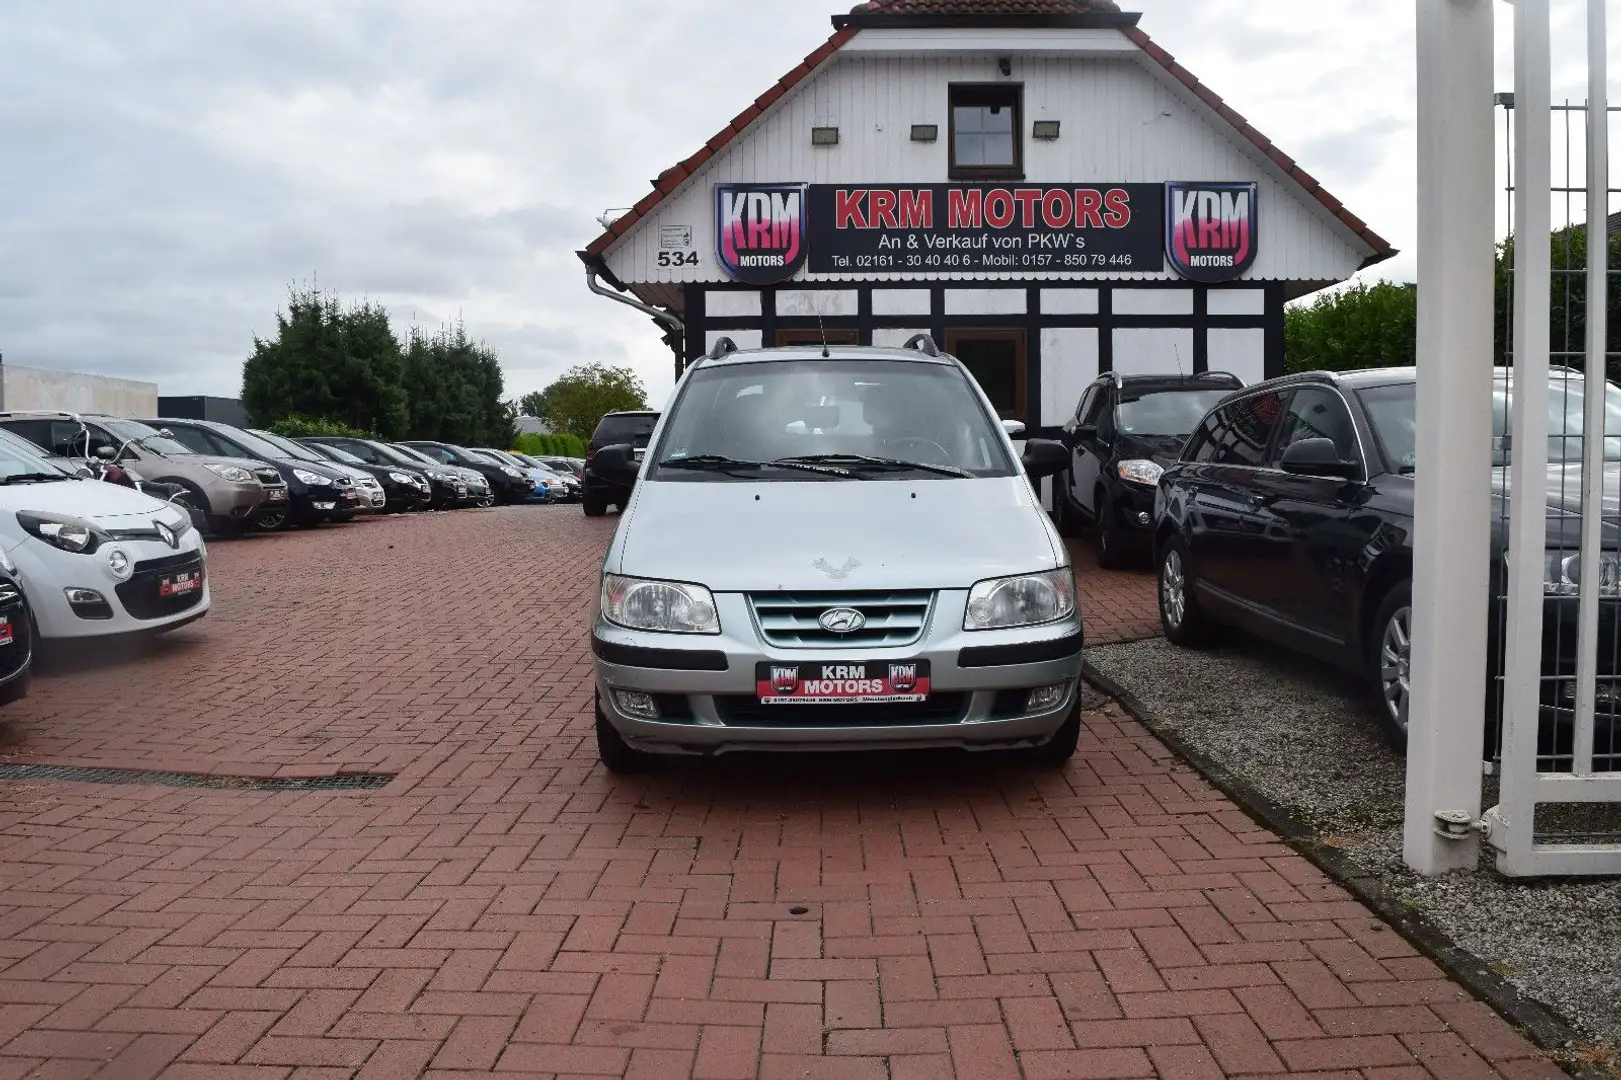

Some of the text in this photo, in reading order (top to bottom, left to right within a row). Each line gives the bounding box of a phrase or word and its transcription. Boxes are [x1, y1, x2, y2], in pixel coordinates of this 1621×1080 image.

[835, 188, 1131, 229] KRM MOTORS
[723, 192, 800, 263] KRM
[1174, 190, 1250, 264] KRM
[878, 234, 901, 249] An
[906, 234, 919, 249] &
[924, 233, 988, 249] Verkauf
[992, 236, 1022, 249] von
[657, 251, 699, 267] 534
[740, 255, 785, 267] MOTORS
[832, 255, 853, 267] Tel.
[856, 255, 894, 267] 02161
[906, 255, 922, 266] 30
[925, 254, 941, 266] 40
[944, 254, 960, 266] 40
[962, 254, 971, 266] 6
[982, 254, 1018, 266] Mobil:
[1022, 254, 1052, 266] 0157
[1064, 254, 1088, 266] 850
[1091, 254, 1106, 266] 79
[1109, 254, 1132, 266] 446
[1190, 255, 1234, 267] MOTORS
[821, 665, 866, 679] KRM
[804, 679, 883, 694] MOTORS
